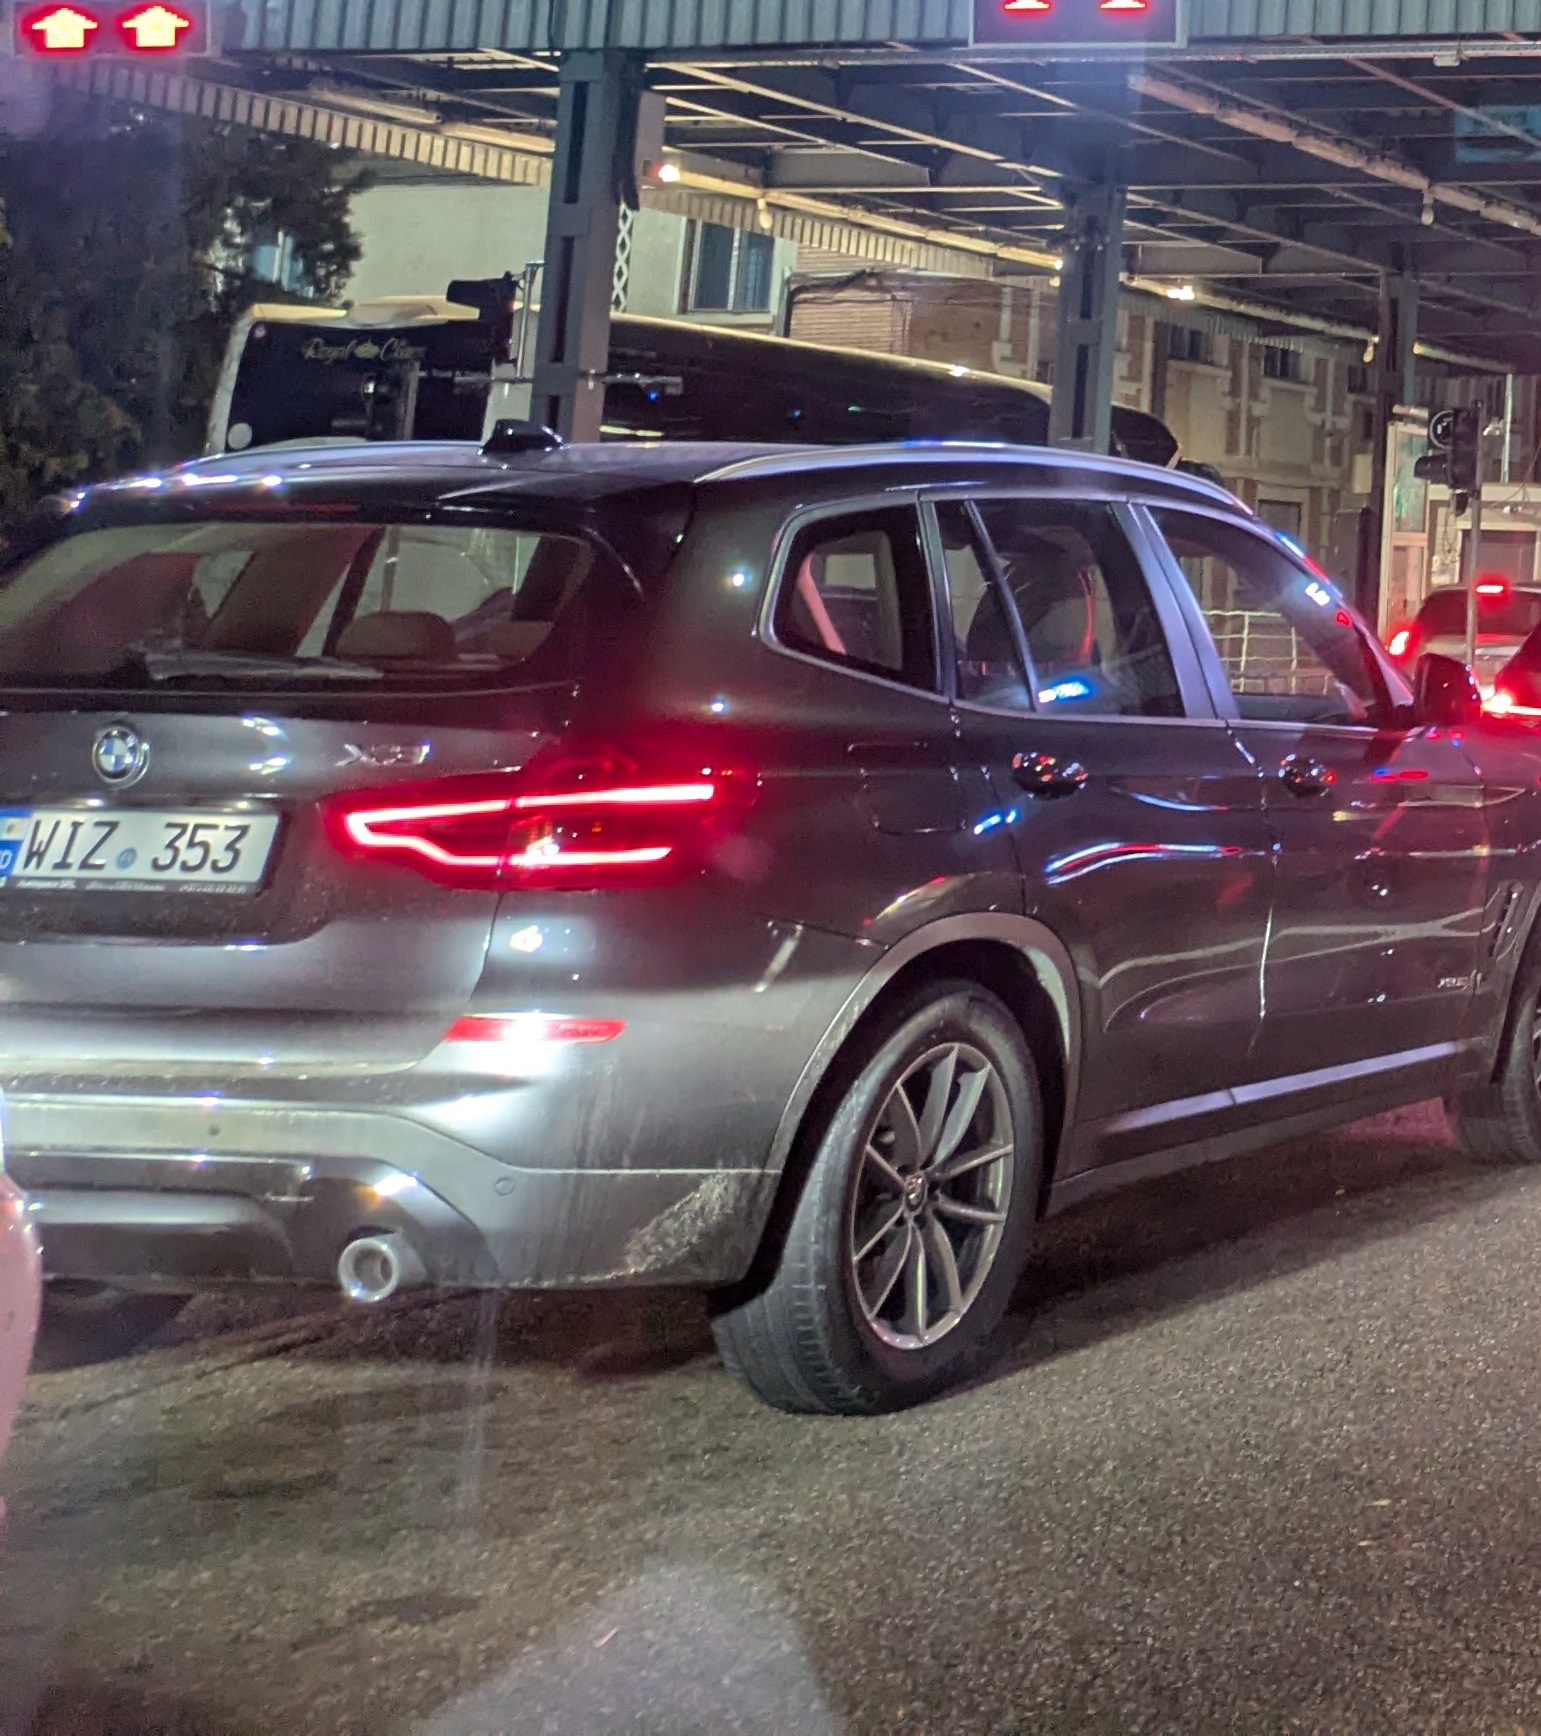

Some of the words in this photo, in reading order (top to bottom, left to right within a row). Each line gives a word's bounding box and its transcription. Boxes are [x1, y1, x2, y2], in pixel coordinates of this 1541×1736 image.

[0, 849, 13, 870] D
[22, 820, 120, 870] WIZ
[151, 822, 251, 873] 353
